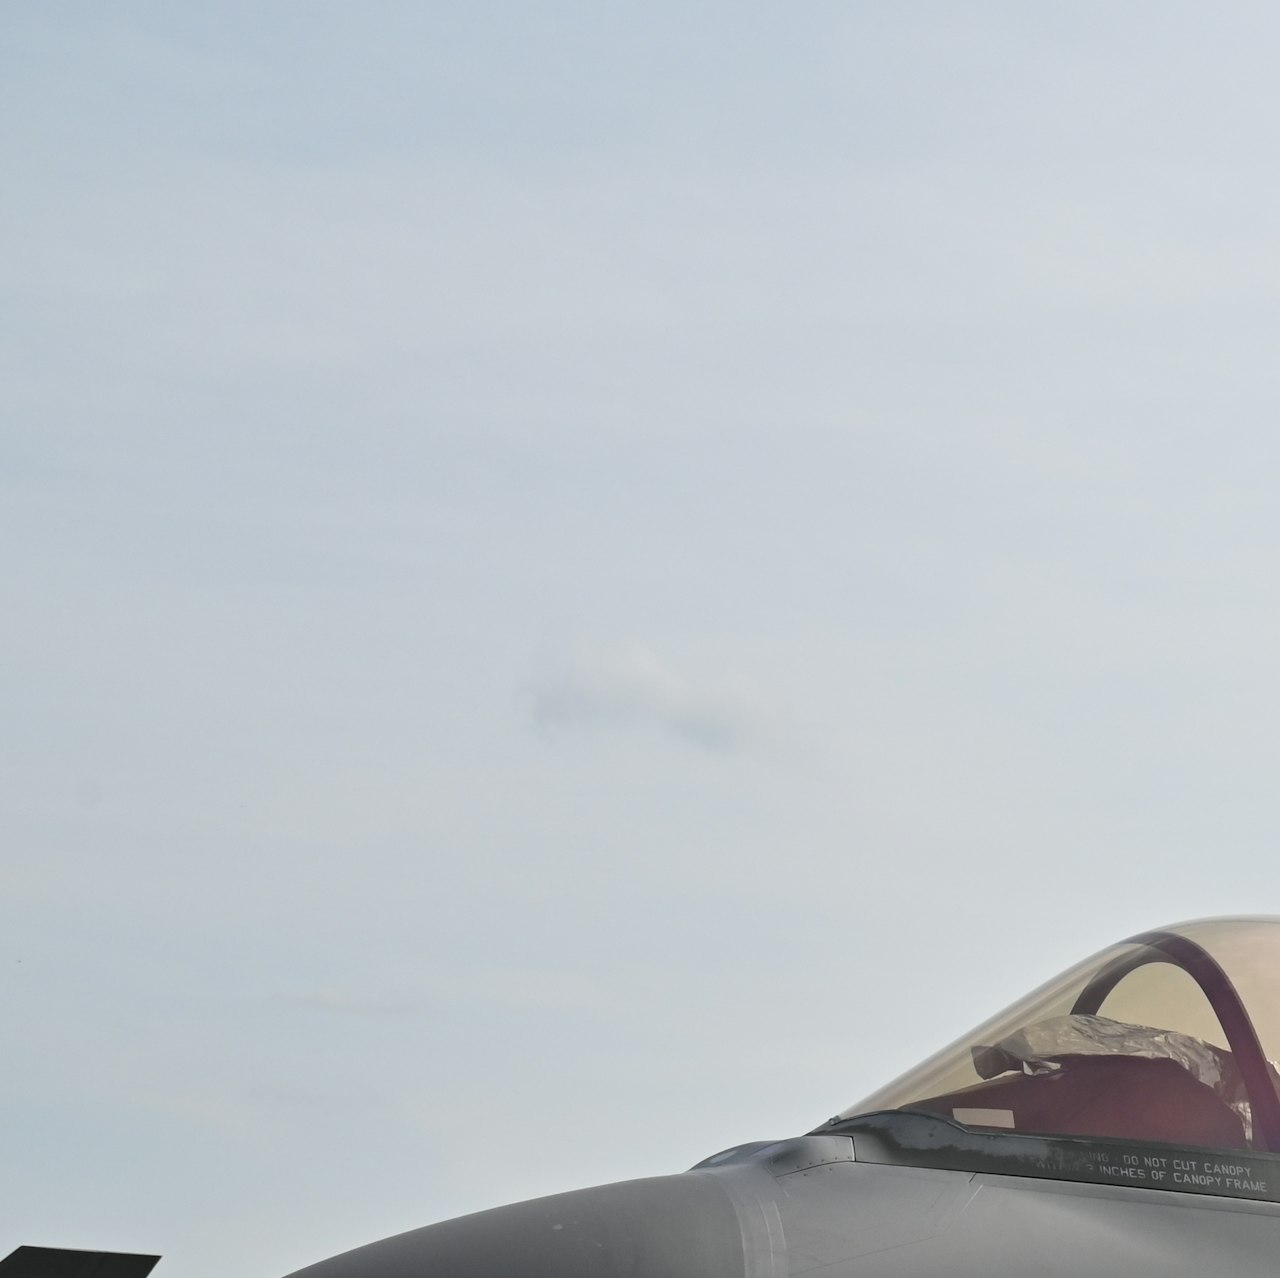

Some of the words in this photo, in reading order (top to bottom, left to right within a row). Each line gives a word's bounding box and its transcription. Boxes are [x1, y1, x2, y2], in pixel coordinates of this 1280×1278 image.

[1099, 1164, 1146, 1180] INCHES
[1151, 1171, 1166, 1182] OF
[1173, 1172, 1220, 1188] CANOPY
[1225, 1178, 1267, 1193] FRAME
[1123, 1155, 1139, 1166] DO
[1144, 1156, 1167, 1169] NOT
[1173, 1159, 1196, 1173] CUT
[1204, 1162, 1251, 1178] CANOPY
